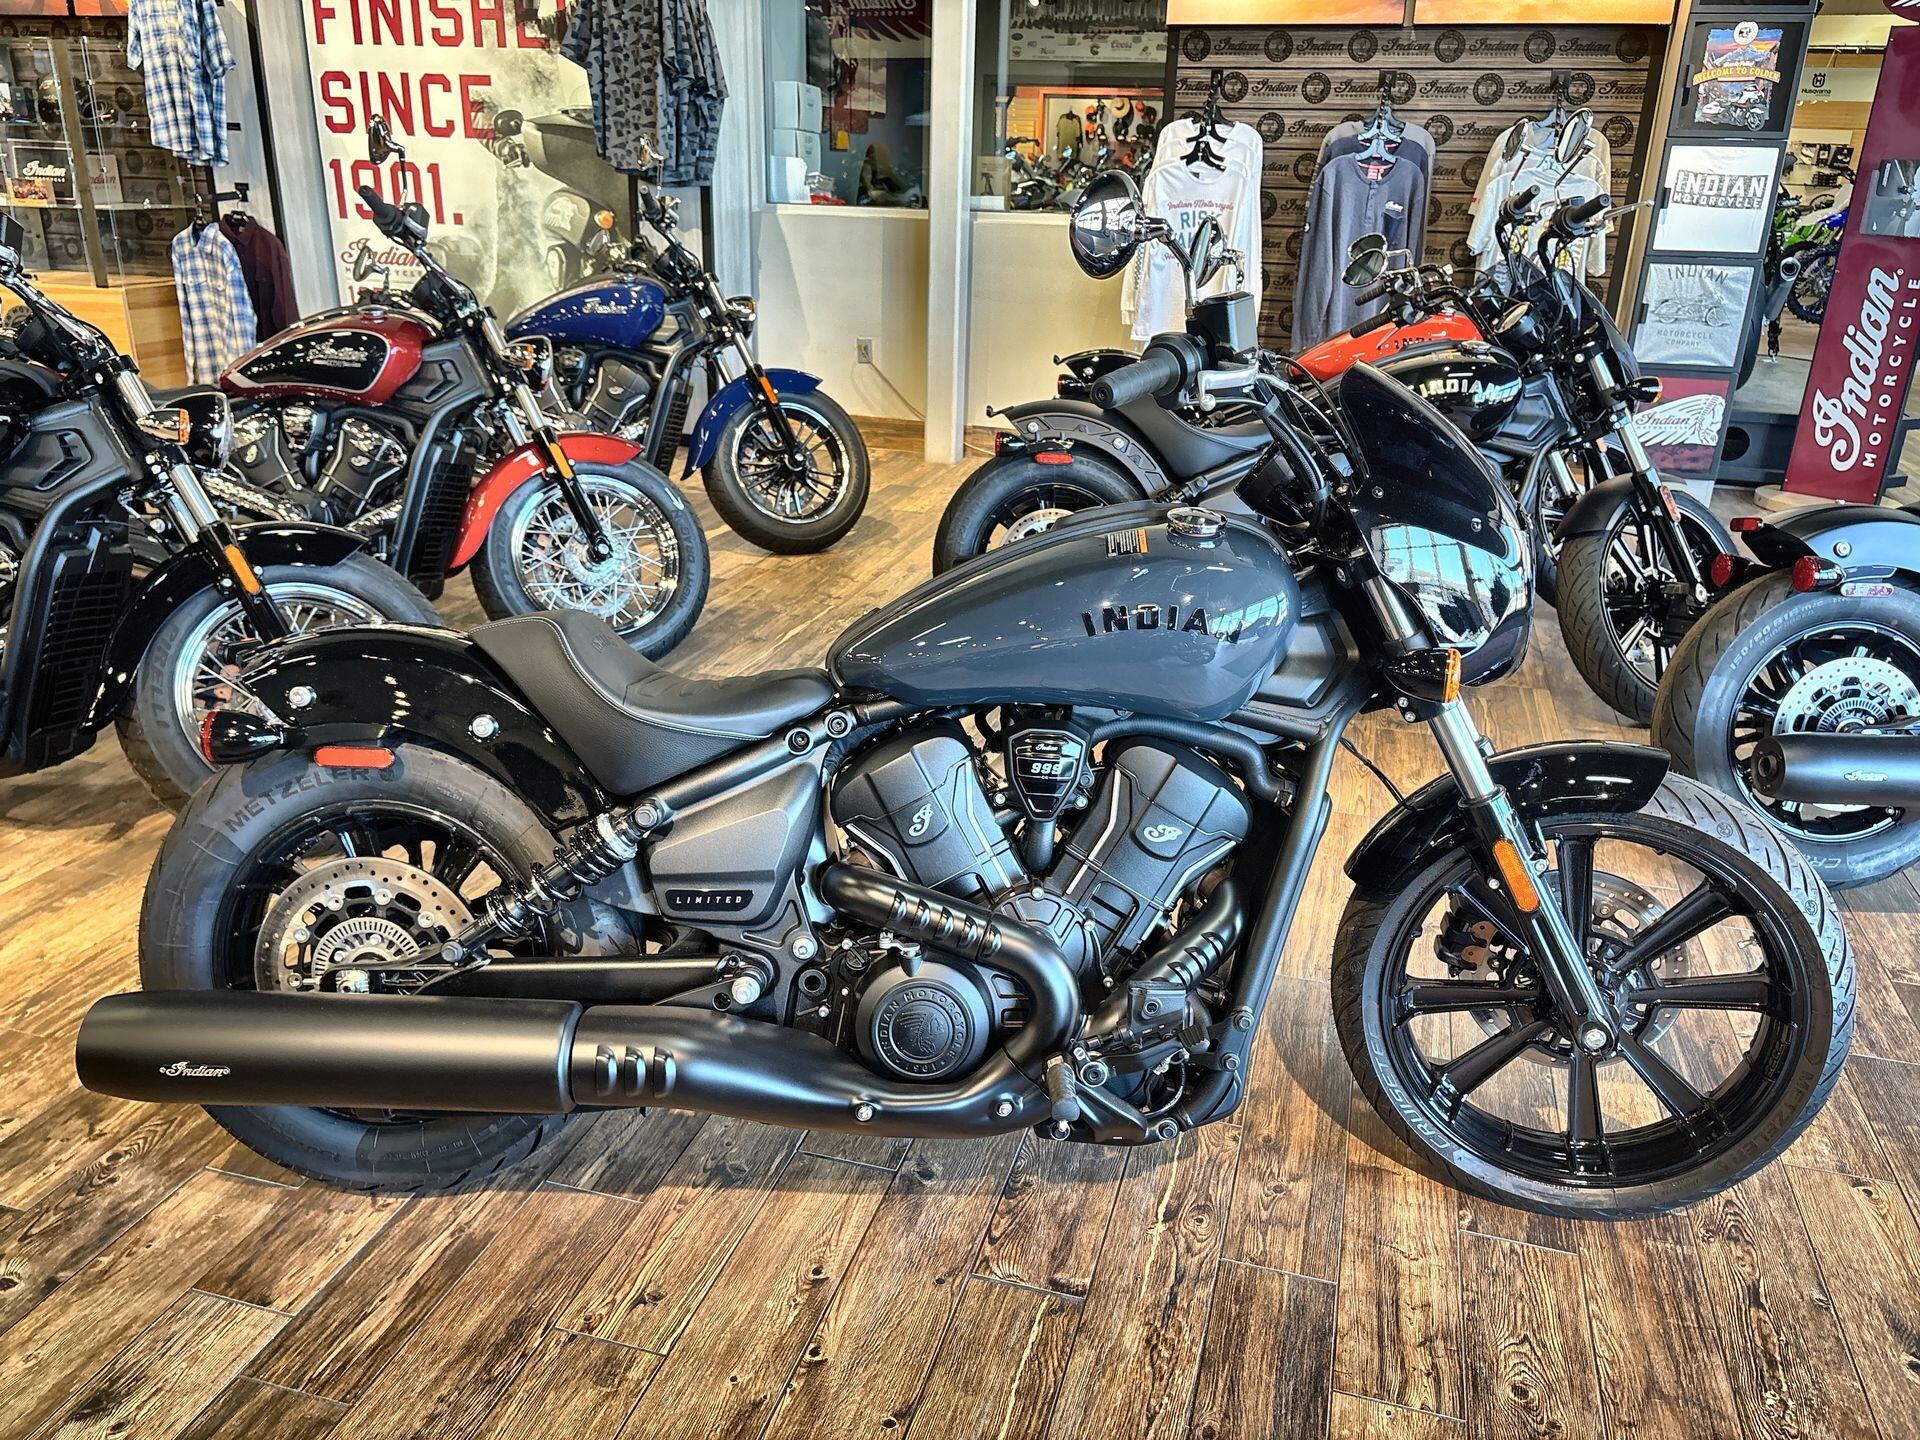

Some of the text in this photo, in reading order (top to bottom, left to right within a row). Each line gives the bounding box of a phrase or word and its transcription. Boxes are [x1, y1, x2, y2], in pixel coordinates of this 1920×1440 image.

[313, 0, 570, 48] FINISHE
[1214, 37, 1260, 51] Indian
[1297, 37, 1344, 51] Indian
[1381, 37, 1430, 51] Indian
[1469, 37, 1519, 51] Indian
[1559, 37, 1611, 51] Indian
[1251, 78, 1298, 93] Indian
[1419, 80, 1469, 94] Indian
[1801, 88, 1832, 97] Husqvarna
[320, 71, 496, 139] SINCE
[23, 160, 66, 176] Indian
[329, 158, 464, 225] 1901.
[1676, 171, 1766, 197] INDIAN
[1673, 192, 1760, 208] MOTORCYCLE
[1180, 210, 1222, 229] RIS
[1668, 264, 1728, 284] INDIAN
[1657, 329, 1713, 340] MOTORCYCLE
[1813, 267, 1899, 472] Indian
[1863, 278, 1920, 468] MOTORCYCLE
[1635, 412, 1691, 426] Indian
[1030, 762, 1063, 775] 999
[222, 767, 371, 833] METZELER
[676, 896, 743, 904] LIMITED
[164, 1060, 224, 1077] Indian
